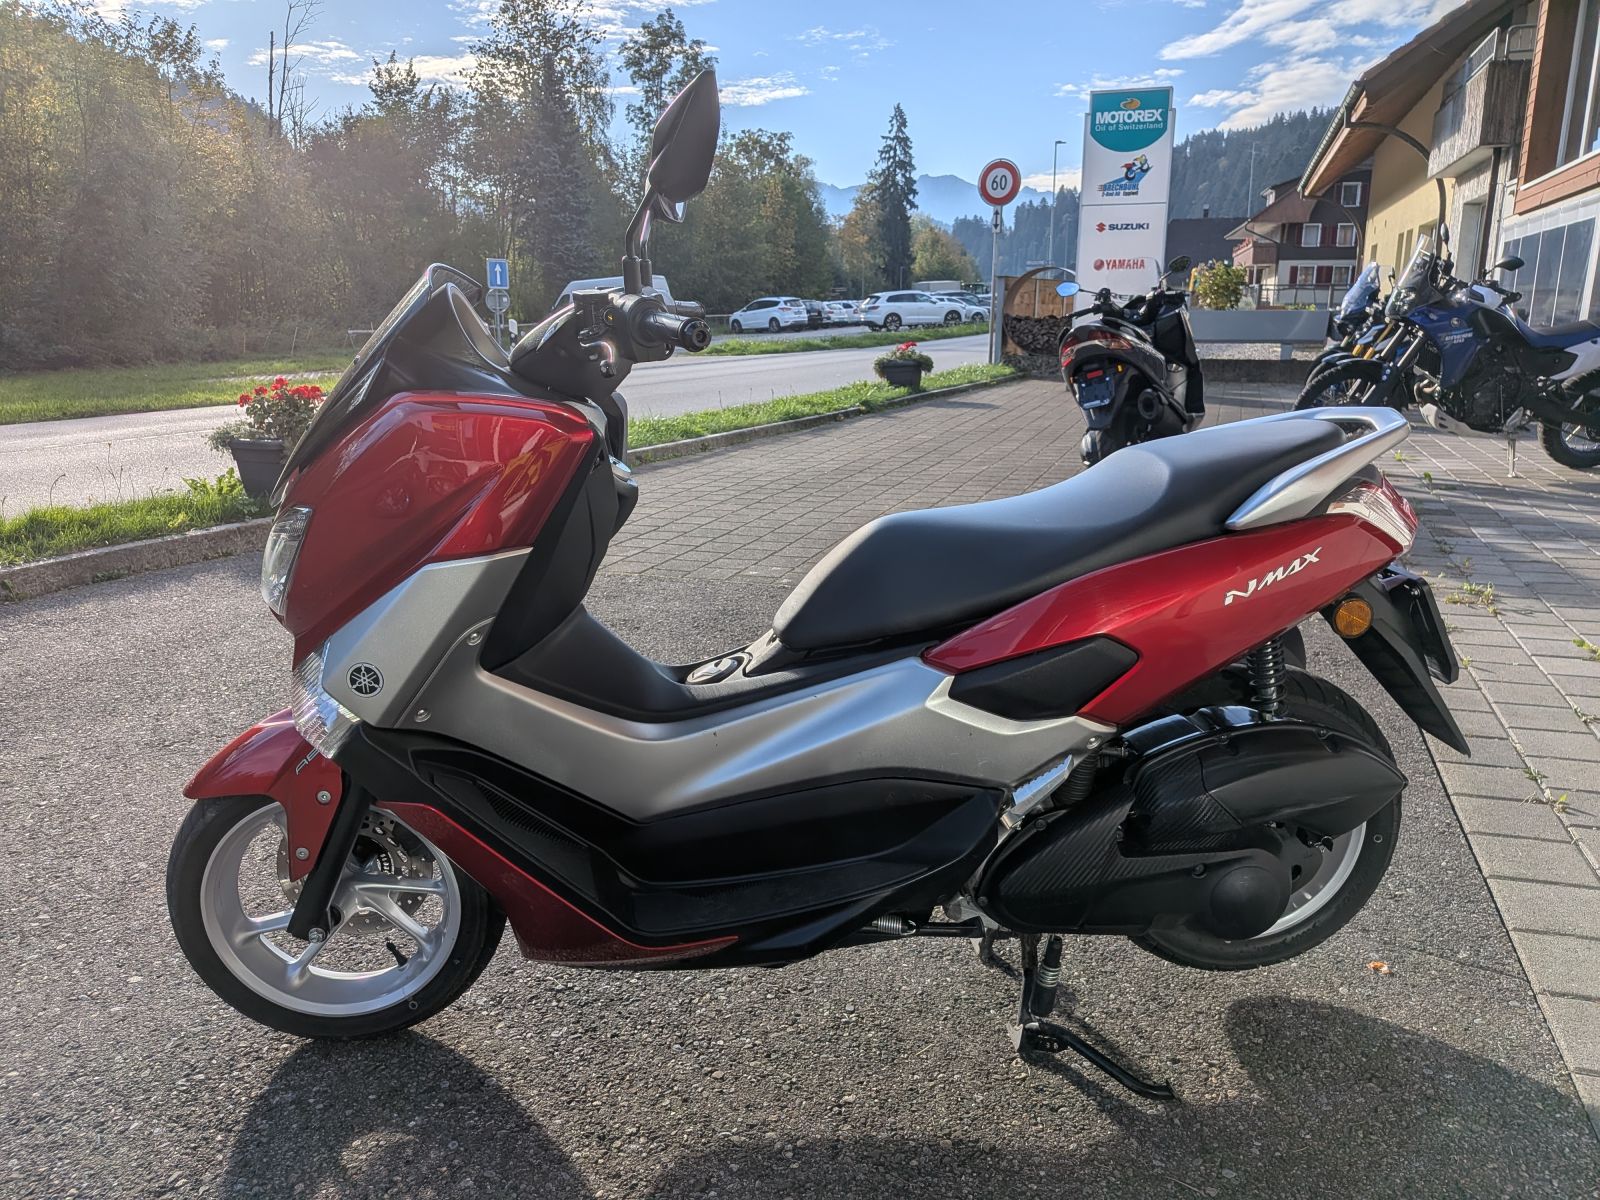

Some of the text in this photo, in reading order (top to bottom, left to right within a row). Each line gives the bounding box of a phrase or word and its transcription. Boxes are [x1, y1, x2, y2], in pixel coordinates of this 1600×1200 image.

[1095, 109, 1162, 124] MOTOREX
[1095, 124, 1106, 132] Oil
[1118, 123, 1163, 131] Switzerland
[991, 174, 1008, 191] 60
[1108, 222, 1150, 231] SUZUKI
[1105, 258, 1145, 270] YAMAHA
